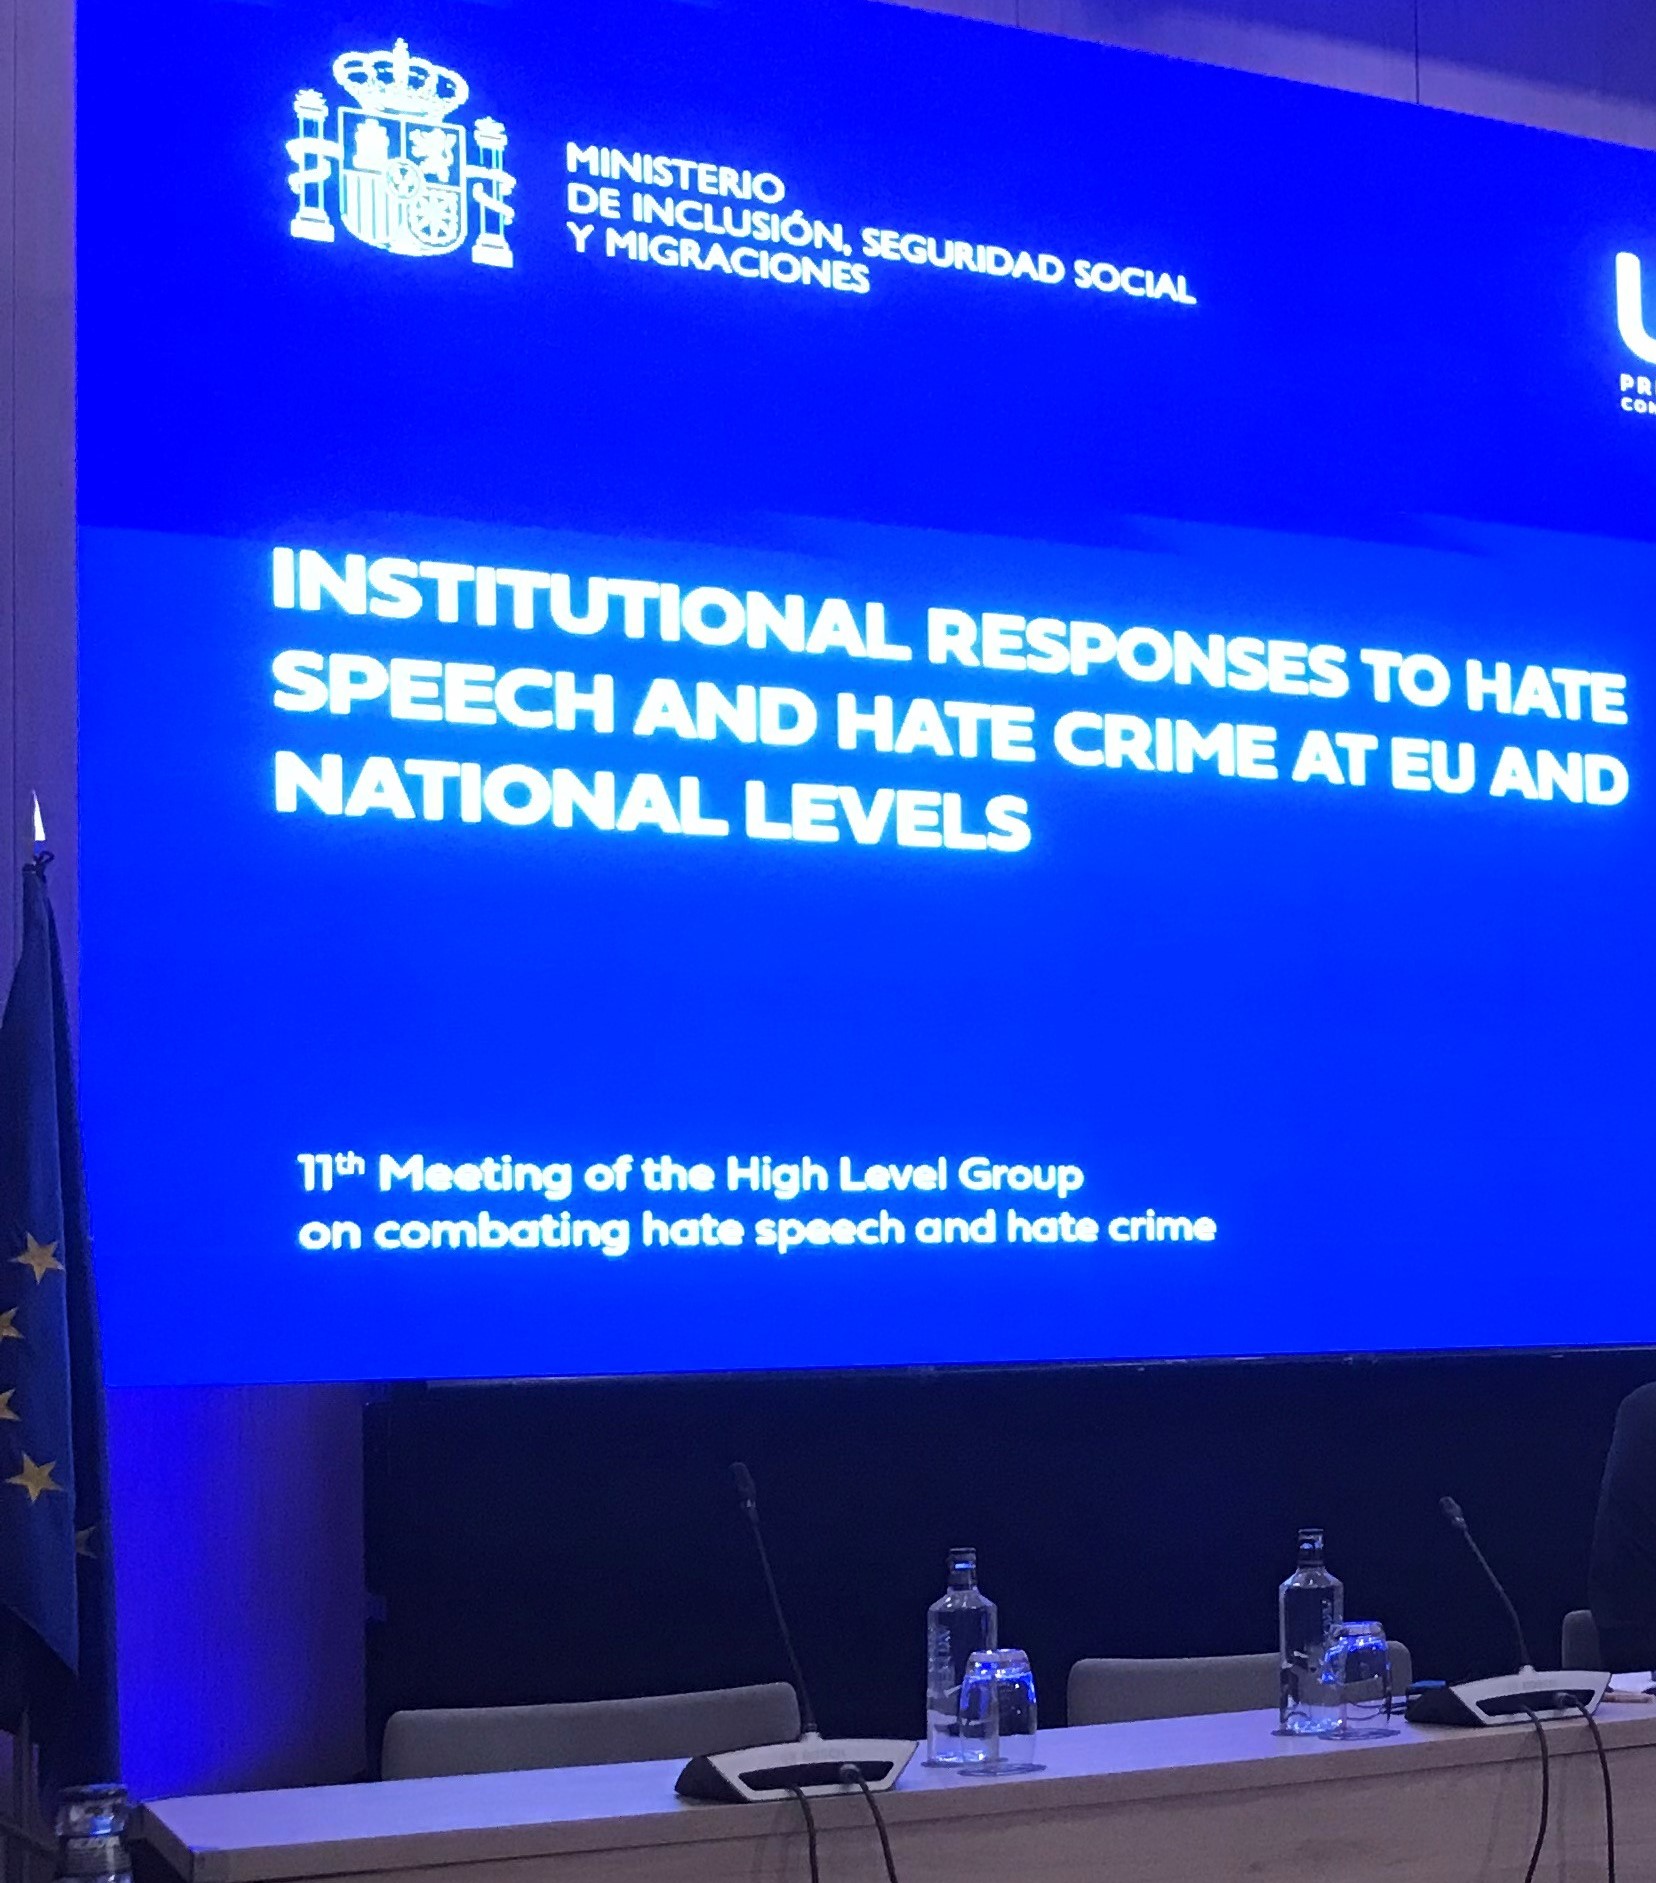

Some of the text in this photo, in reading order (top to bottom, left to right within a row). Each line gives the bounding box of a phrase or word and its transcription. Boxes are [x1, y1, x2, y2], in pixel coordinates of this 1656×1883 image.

[566, 141, 786, 204] MINISTERIO
[566, 221, 870, 294] Y MIGRACIONES
[567, 182, 1197, 305] DE INCLUSIÓN, SEGURIDAD SOCIAL
[272, 547, 1628, 725] INSTITUTIONAL RESPONSES TO HATE
[271, 649, 1629, 806] SPEECH AND HATE CRIME AT EU AND
[275, 750, 1031, 852] NATIONAL LEVELS
[297, 1150, 1085, 1201] 11th Meeting of the High Level Group
[298, 1208, 1217, 1257] on combating hate speech and hate crime
